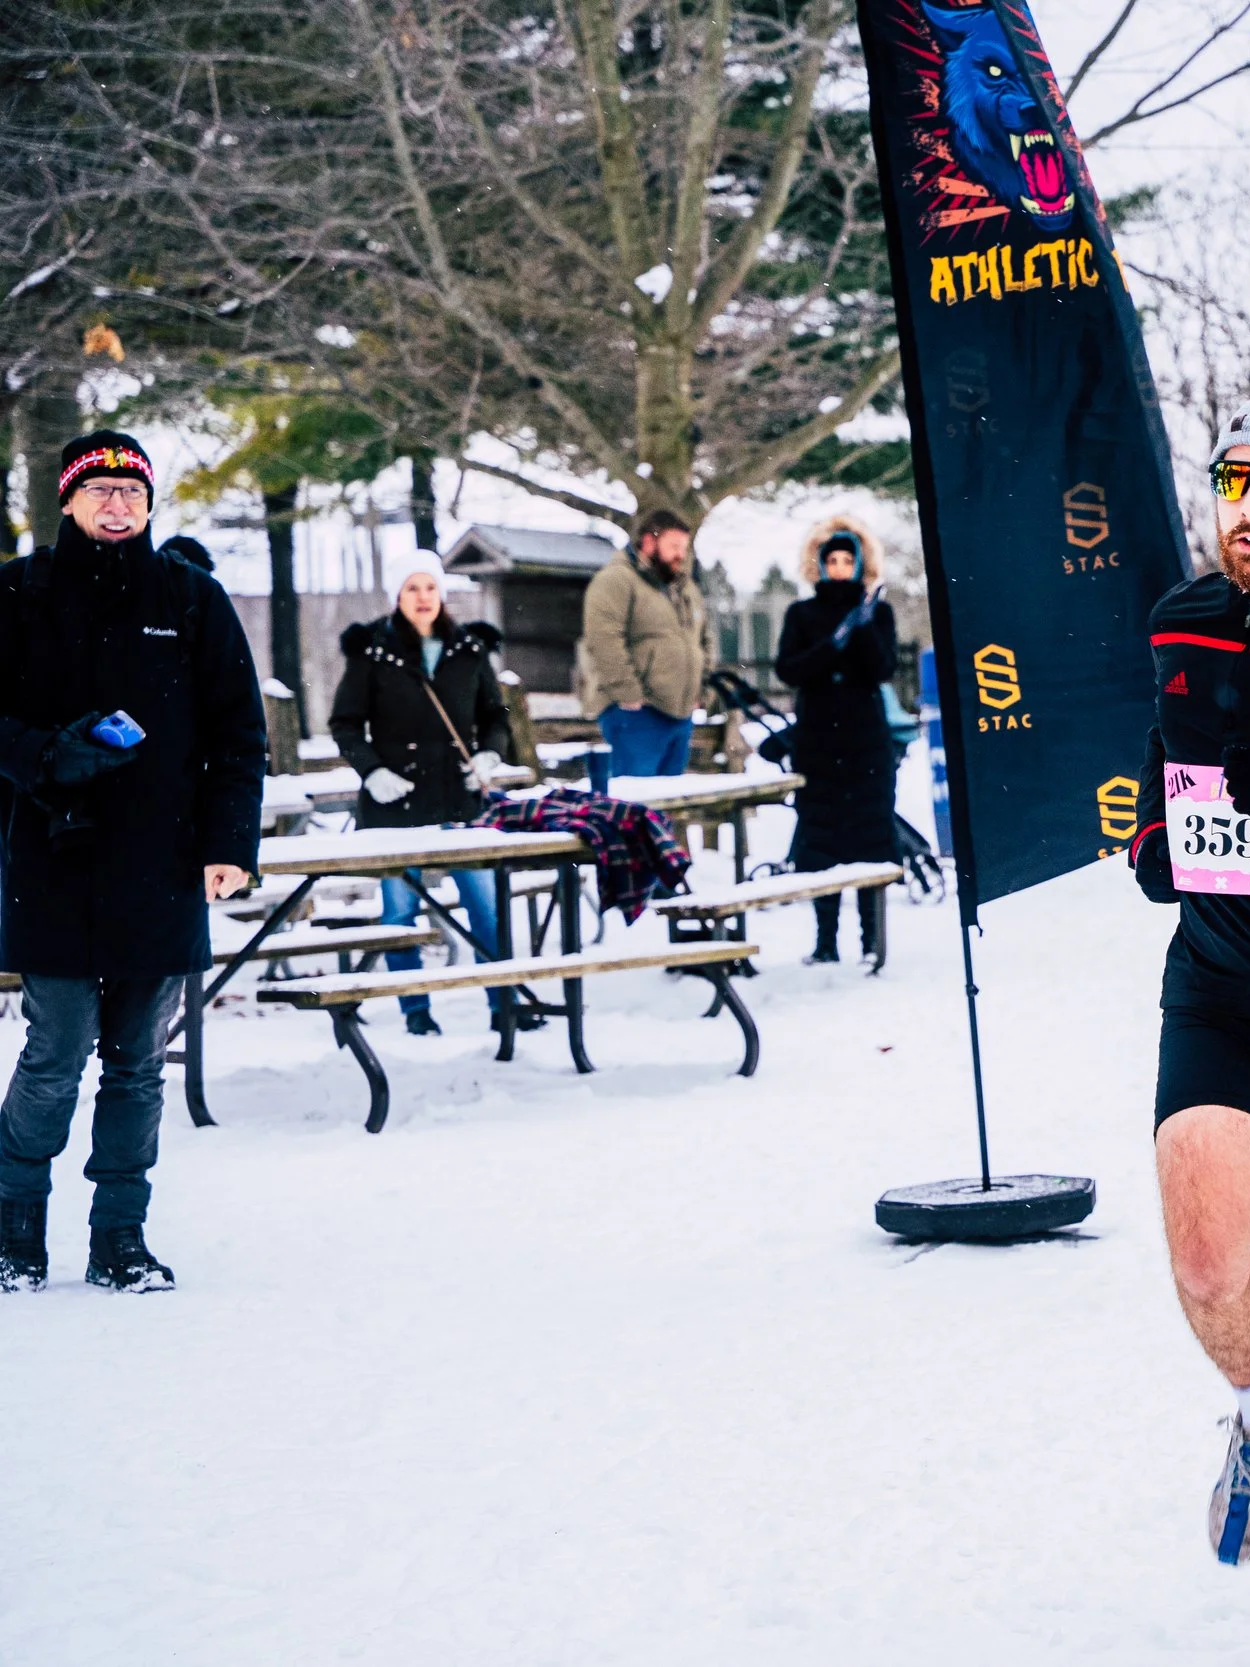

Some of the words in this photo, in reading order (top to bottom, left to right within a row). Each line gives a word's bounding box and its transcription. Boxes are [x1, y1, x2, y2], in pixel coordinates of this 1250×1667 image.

[930, 237, 1100, 306] ATHLETIC
[1063, 552, 1120, 575] STAC
[978, 713, 1032, 732] STAC
[1168, 766, 1197, 799] 21K
